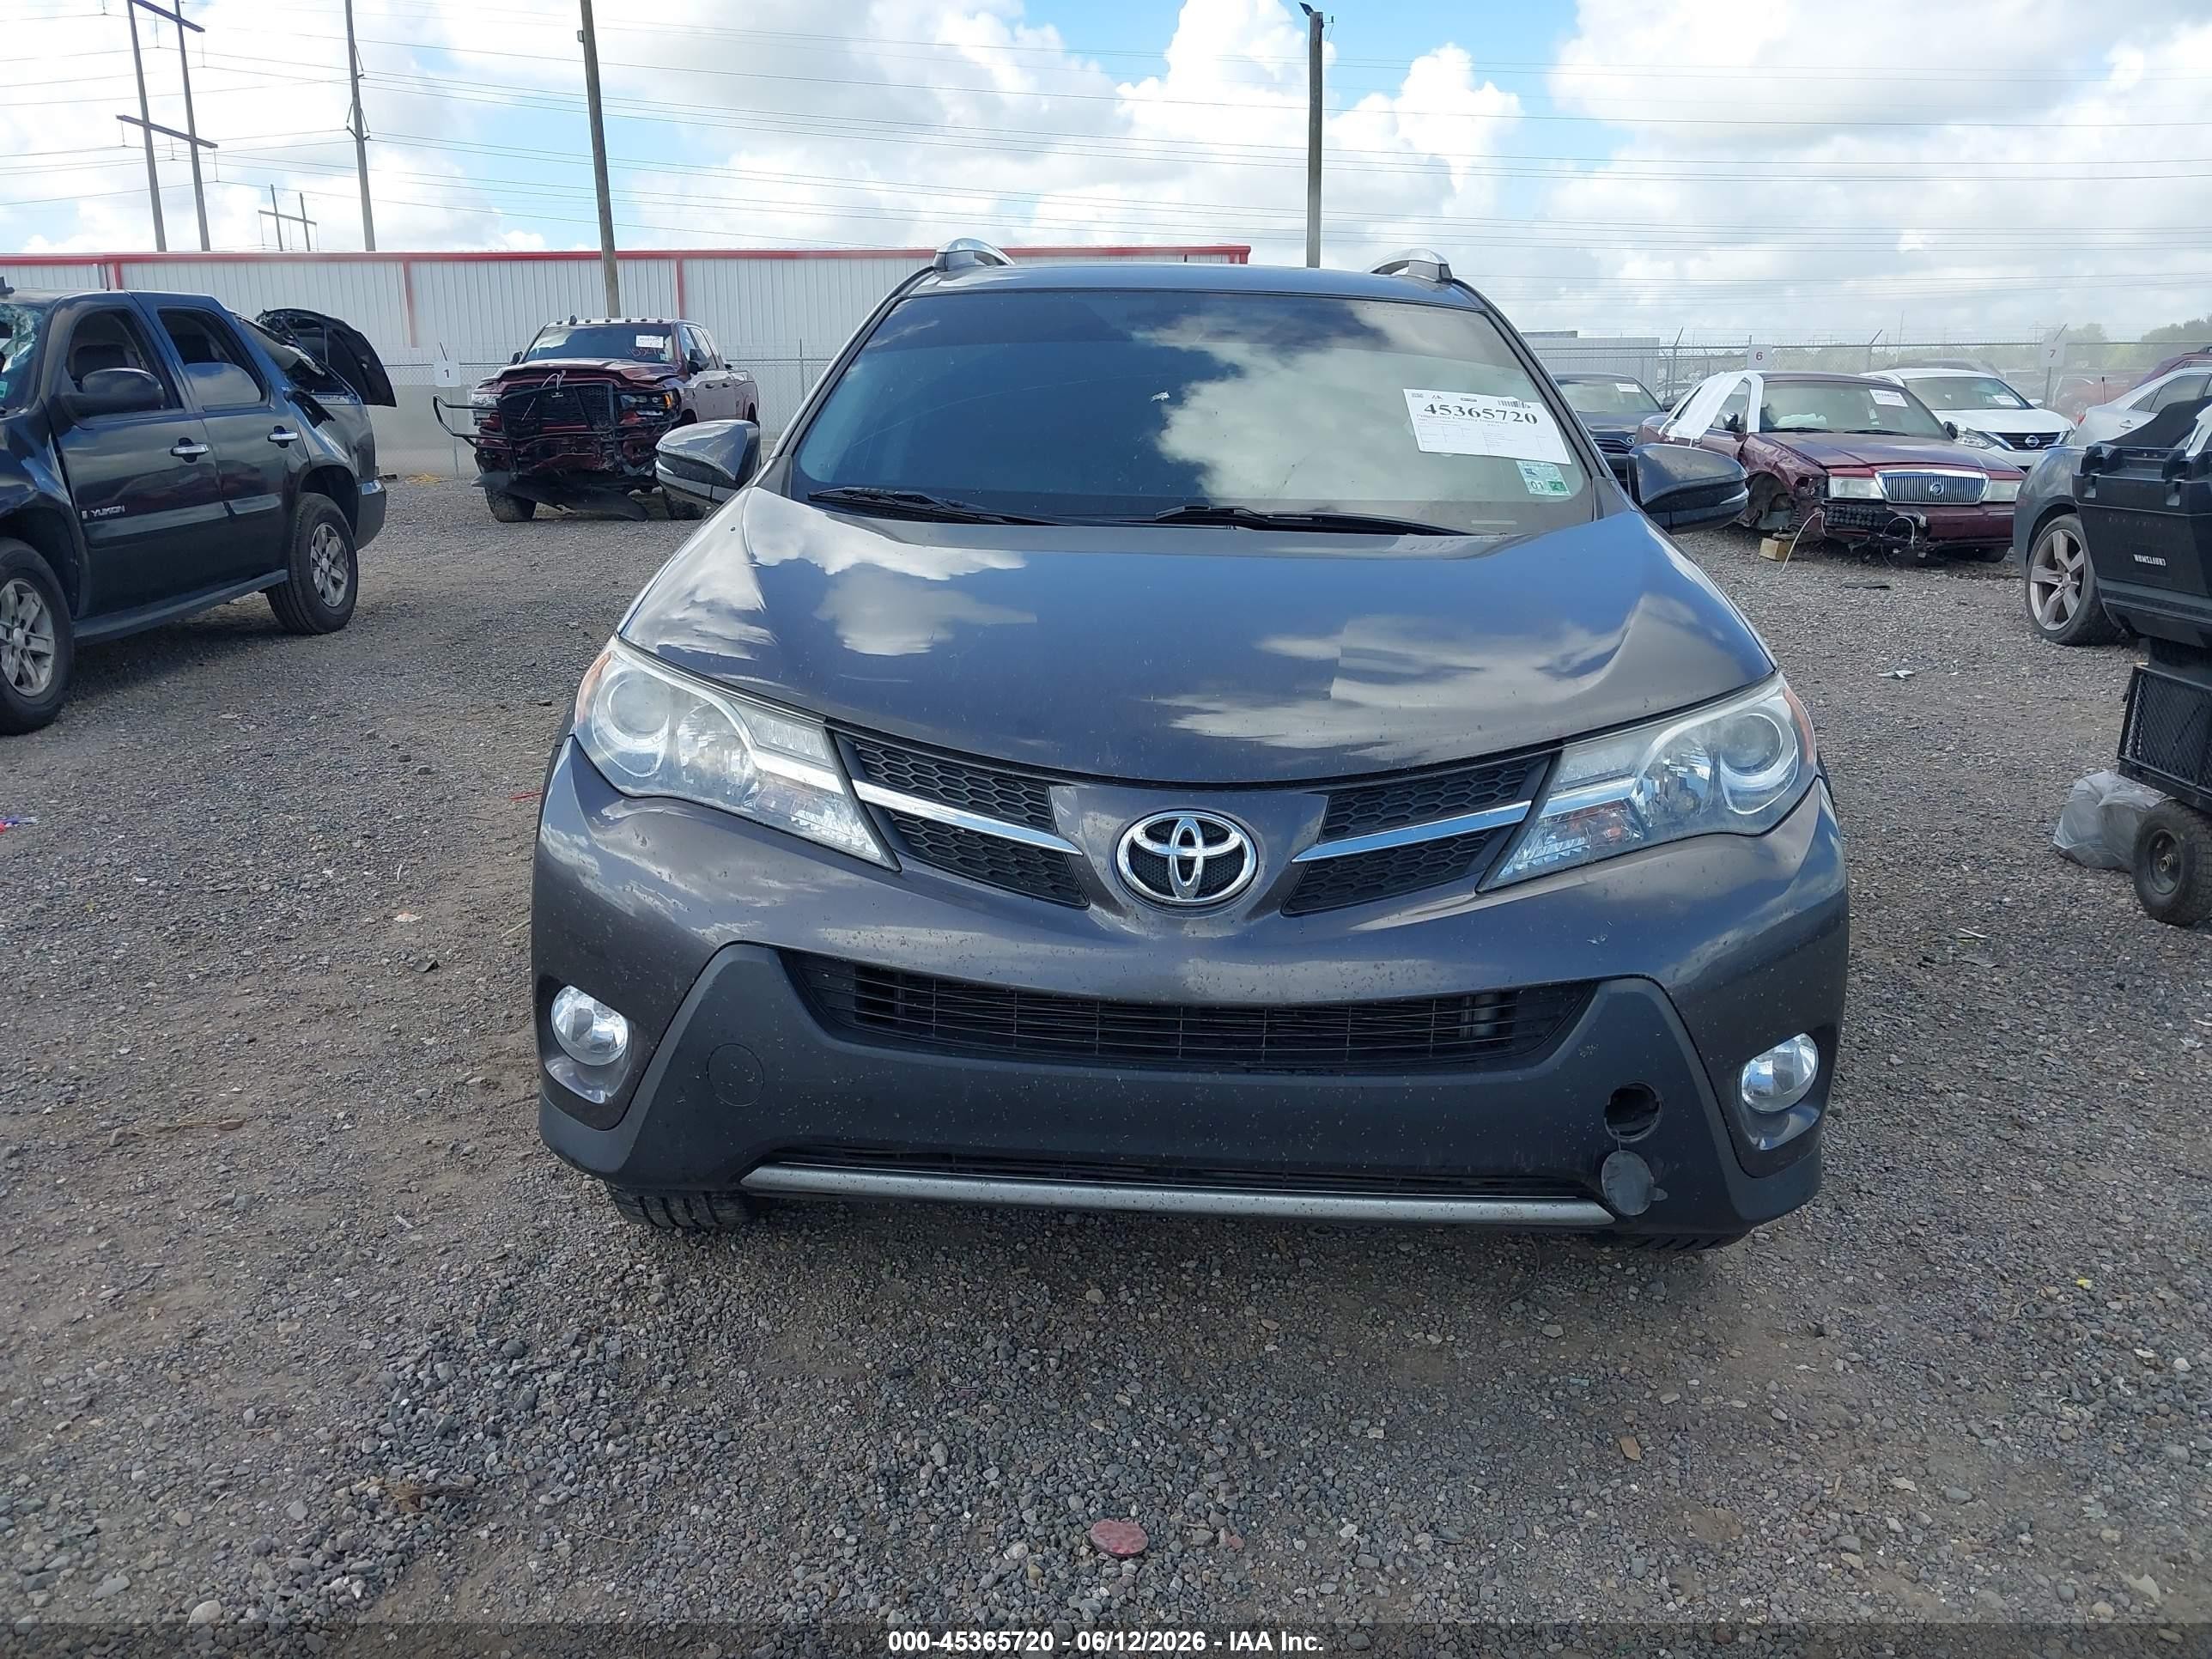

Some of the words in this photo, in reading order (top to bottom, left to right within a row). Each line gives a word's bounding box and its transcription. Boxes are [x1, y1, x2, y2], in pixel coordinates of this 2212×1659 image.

[1755, 351, 1763, 361] 6
[2050, 349, 2056, 358] 7
[444, 368, 450, 379] 1
[1424, 404, 1538, 424] 45365720
[1530, 481, 1545, 489] 01
[90, 505, 125, 517] YUKON
[2132, 554, 2166, 567] CRAFTSMAN
